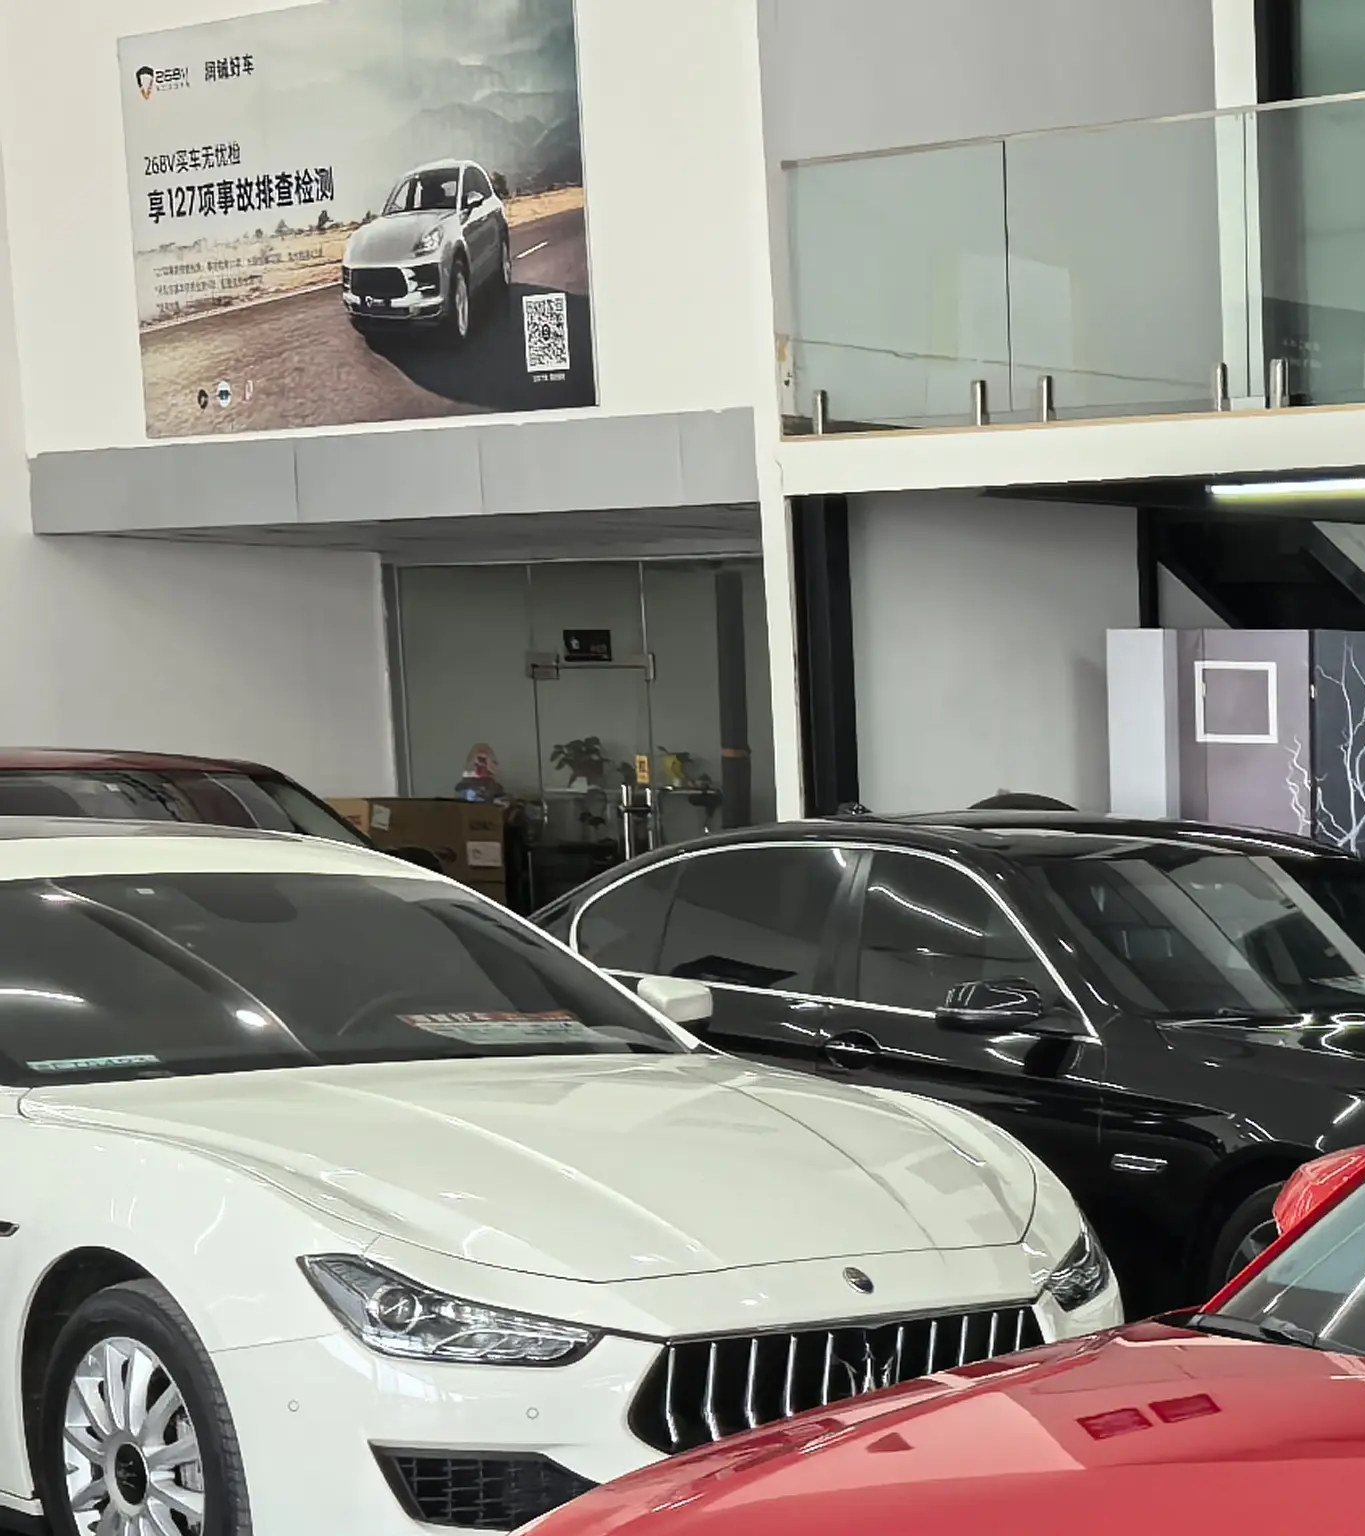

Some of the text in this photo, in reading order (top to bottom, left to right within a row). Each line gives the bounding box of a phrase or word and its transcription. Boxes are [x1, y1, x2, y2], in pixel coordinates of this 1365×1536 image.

[147, 165, 335, 225] 享127项事故排查检测
